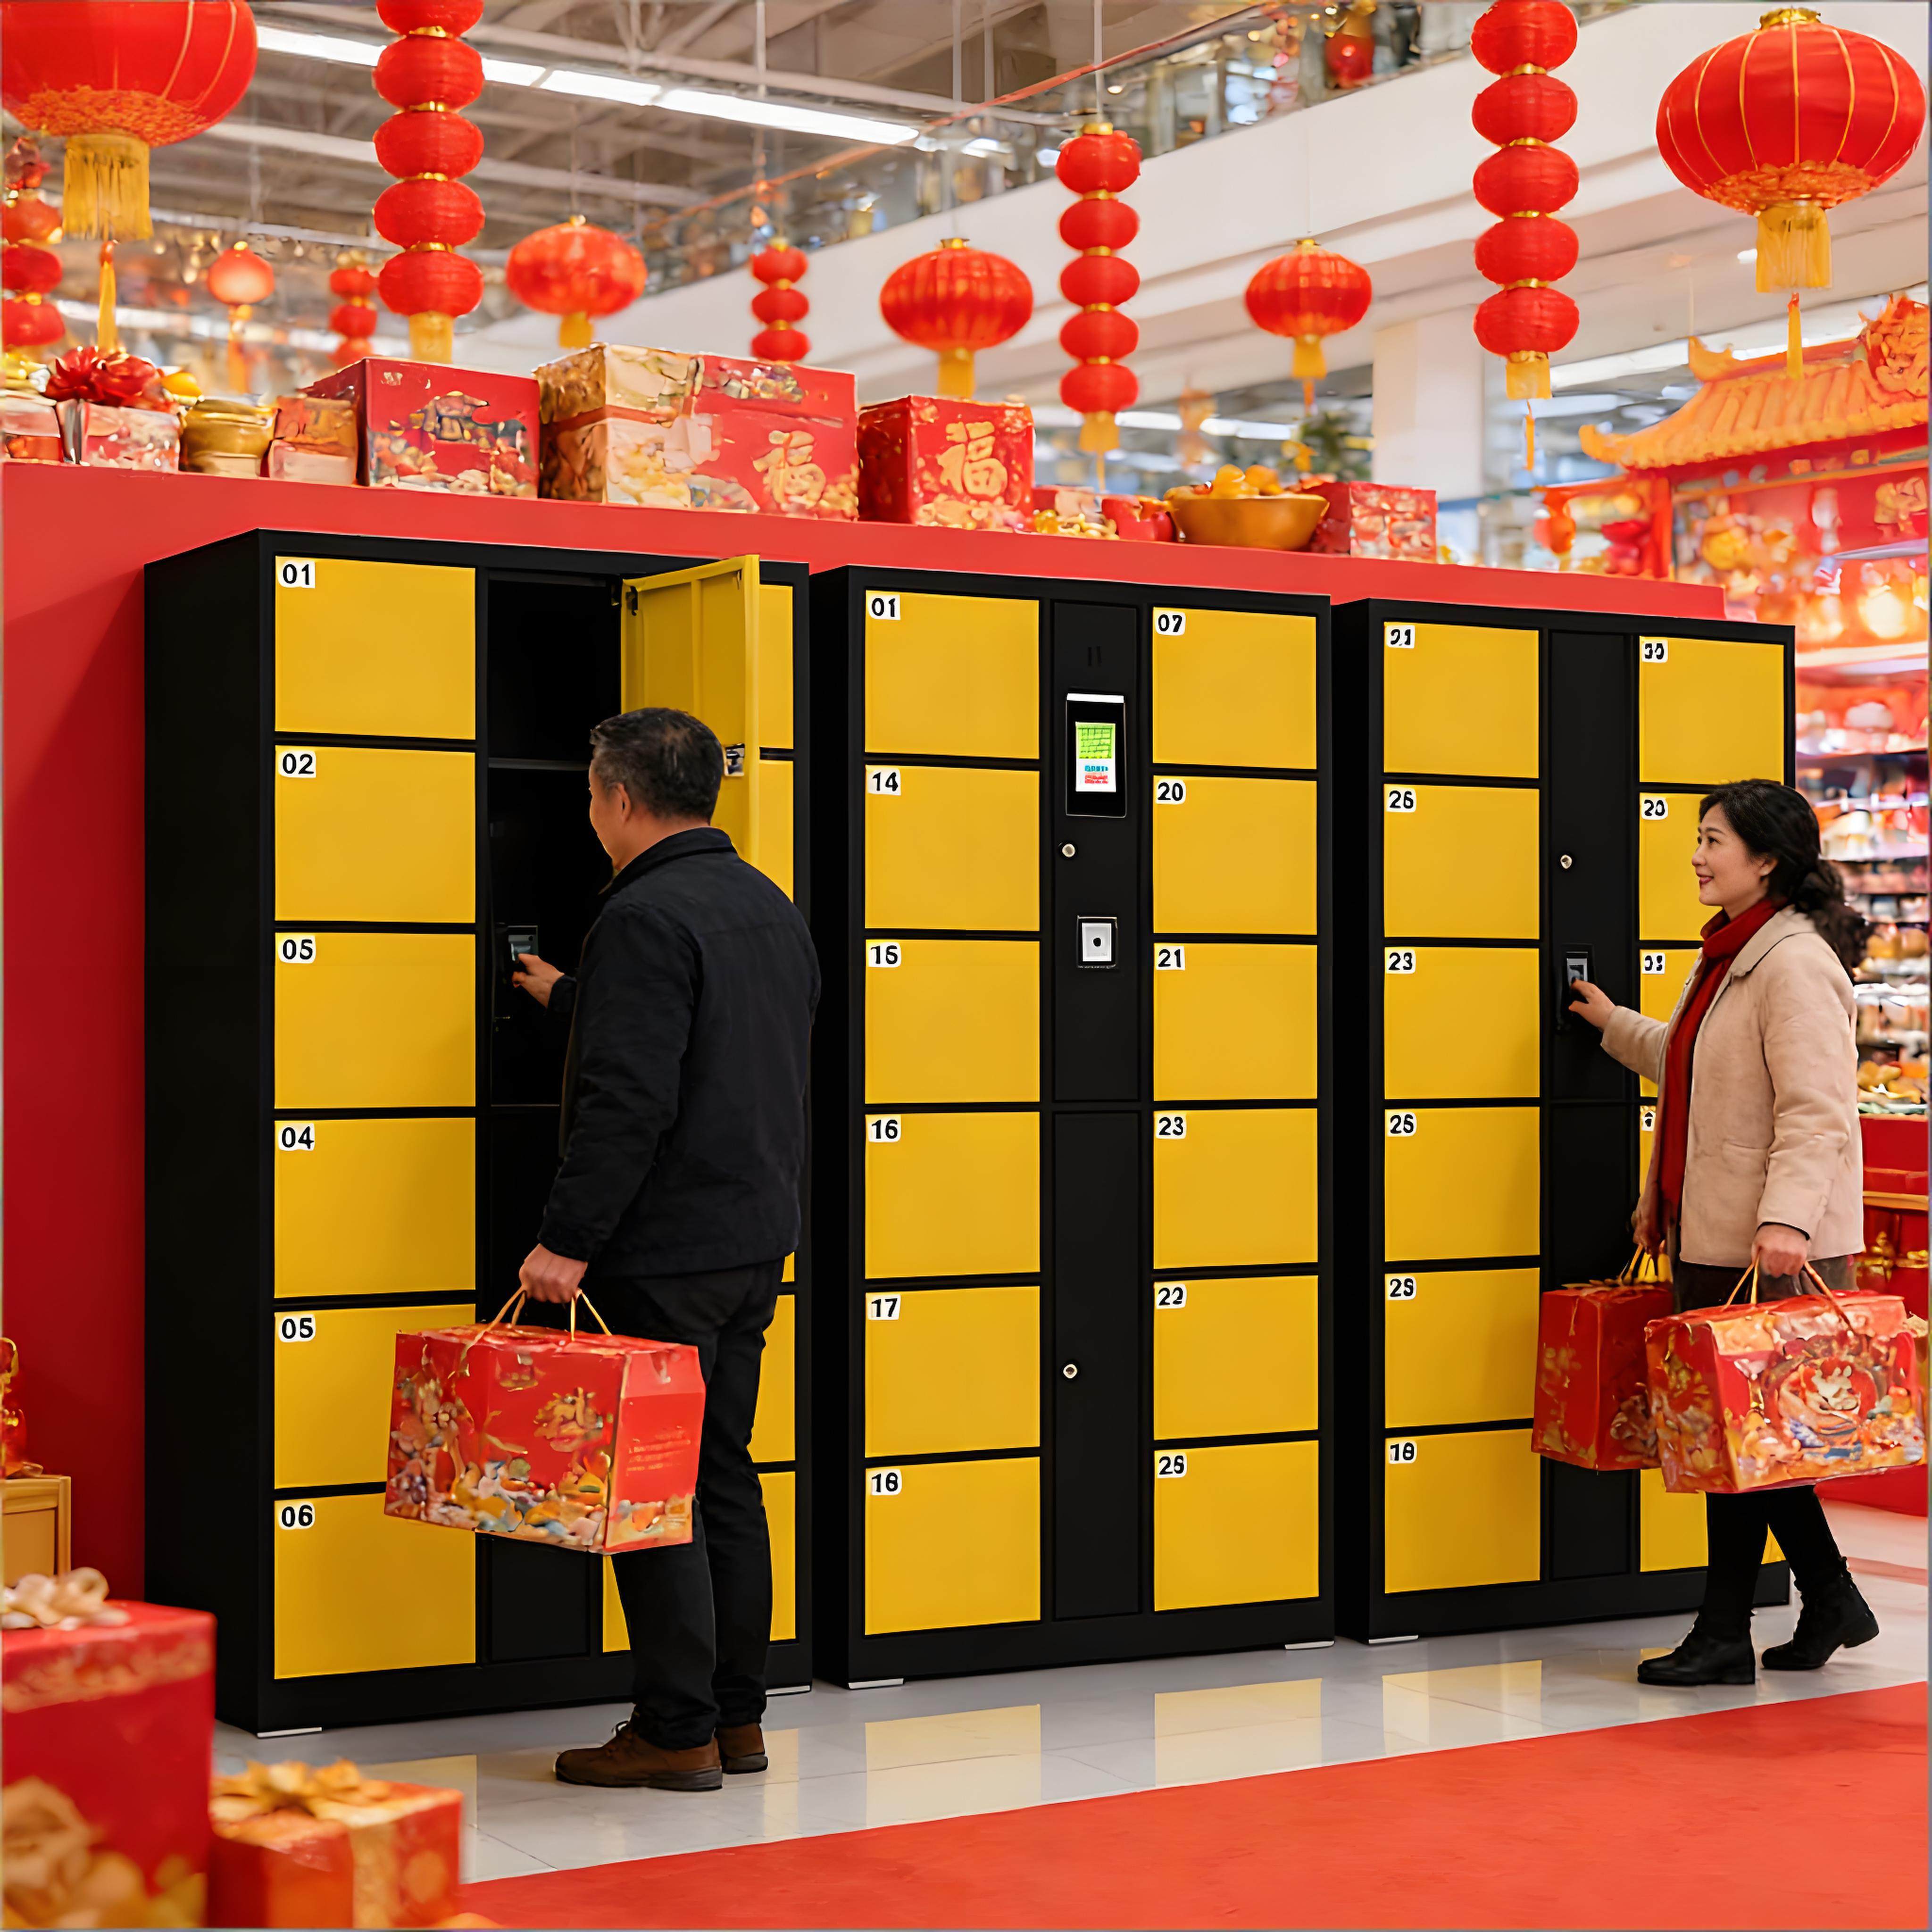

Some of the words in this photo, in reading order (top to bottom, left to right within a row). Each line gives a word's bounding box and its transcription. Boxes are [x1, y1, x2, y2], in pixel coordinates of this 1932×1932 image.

[283, 564, 309, 585] 01
[871, 598, 895, 617] 01
[1158, 614, 1183, 633] 07
[283, 753, 314, 774] 02
[872, 772, 899, 791] 14
[1158, 782, 1183, 801] 20
[283, 939, 313, 960] 05
[1158, 949, 1182, 968] 21
[282, 1126, 314, 1149] 04
[872, 1119, 898, 1139] 16
[871, 1298, 898, 1317] 17
[282, 1317, 313, 1339] 05
[282, 1505, 313, 1527] 06
